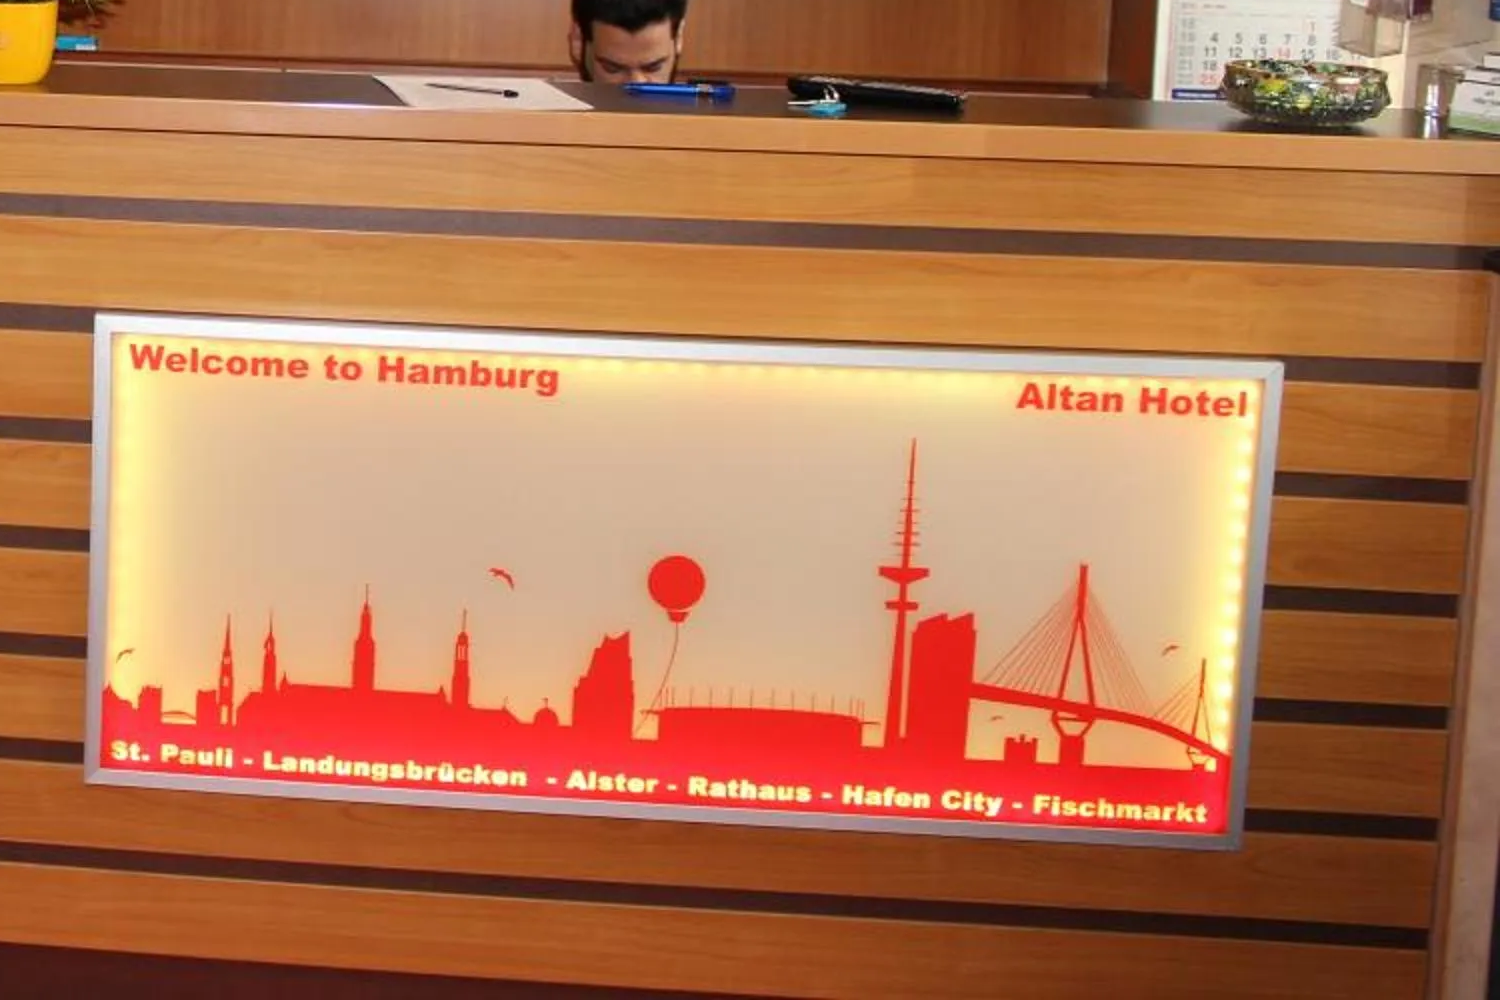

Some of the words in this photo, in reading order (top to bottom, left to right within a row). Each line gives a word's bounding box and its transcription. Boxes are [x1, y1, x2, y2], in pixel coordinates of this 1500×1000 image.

[129, 343, 309, 381] Welcome
[323, 354, 363, 382] to
[377, 355, 560, 398] Hamburg
[1015, 382, 1124, 413] Altan
[1139, 387, 1248, 417] Hotel
[111, 738, 150, 763] St.
[160, 743, 233, 769] Pauli
[263, 750, 527, 788] Landungsbrücken
[565, 769, 658, 796] Alster
[687, 775, 812, 803] Rathaus
[841, 783, 931, 809] Hafen
[940, 788, 1003, 816] City
[1032, 794, 1208, 825] Fischmarkt
